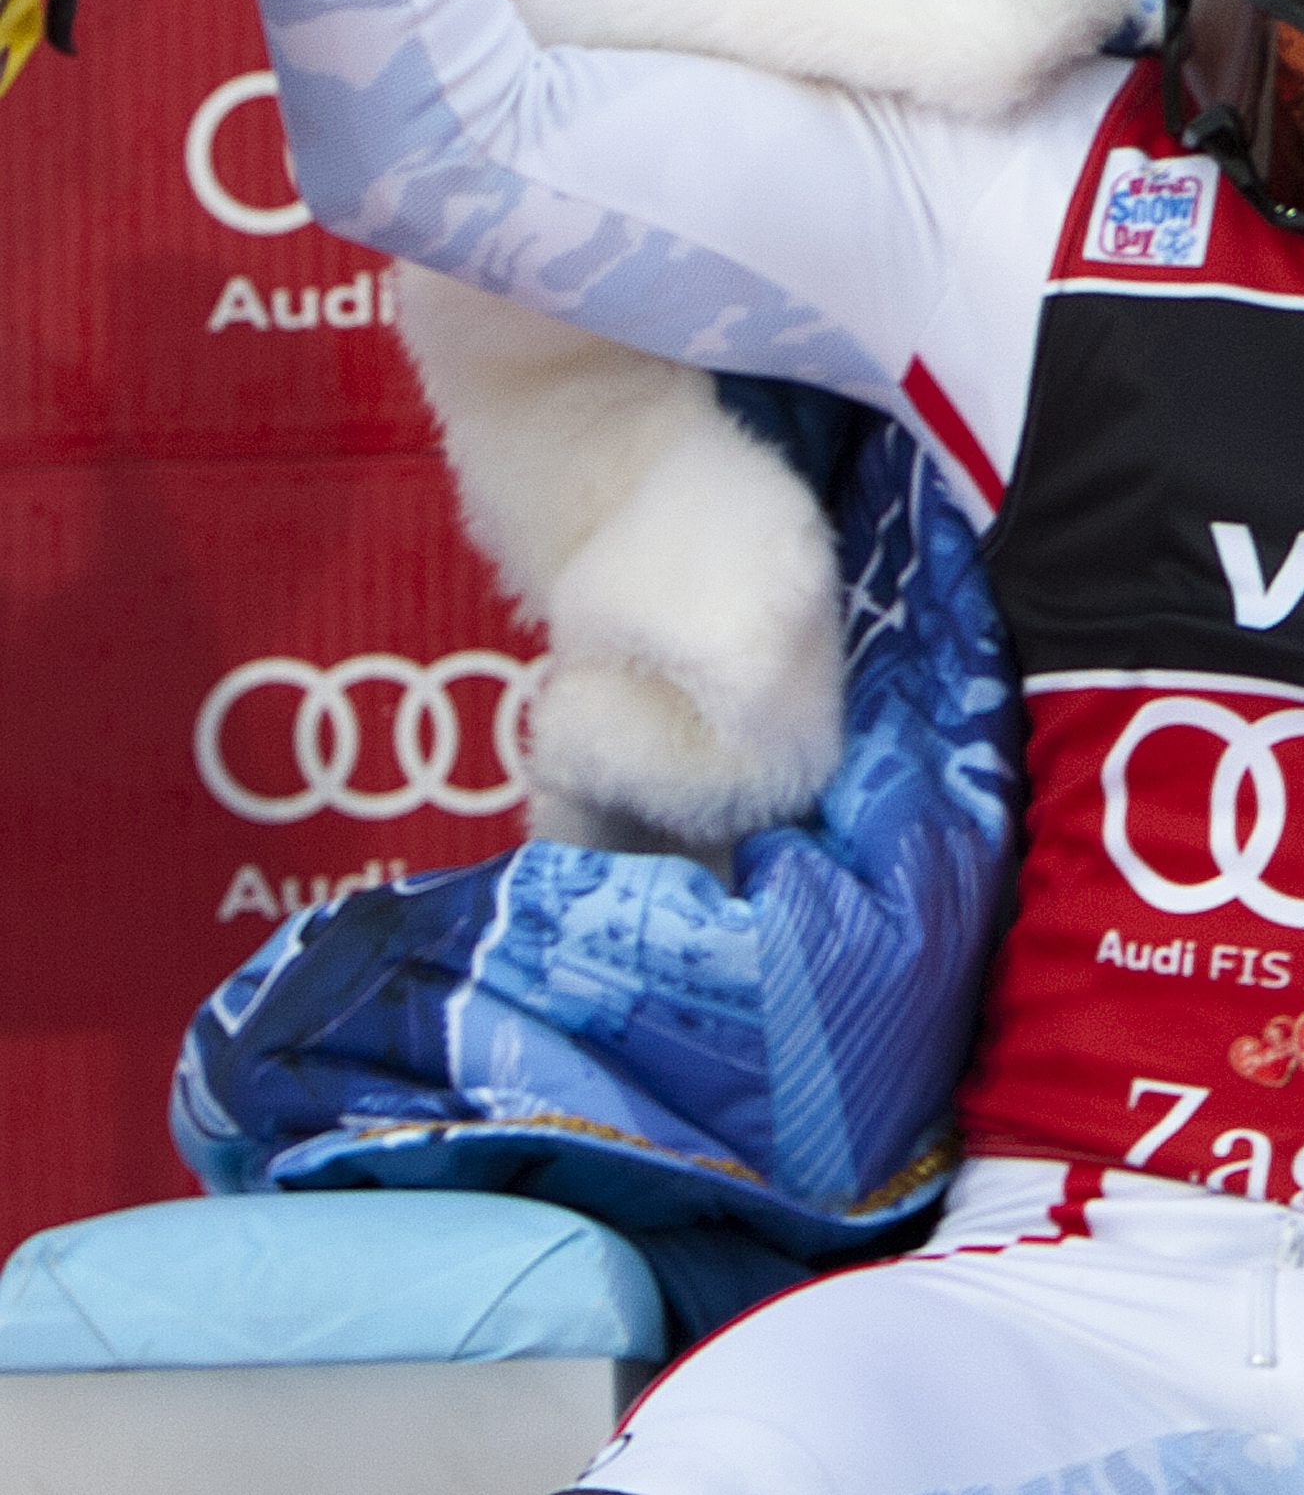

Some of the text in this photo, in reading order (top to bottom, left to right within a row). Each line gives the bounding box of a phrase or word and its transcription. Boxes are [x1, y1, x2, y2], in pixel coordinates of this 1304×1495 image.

[206, 273, 397, 334] Audi
[1095, 928, 1197, 978] Audi
[1208, 944, 1291, 989] FIS
